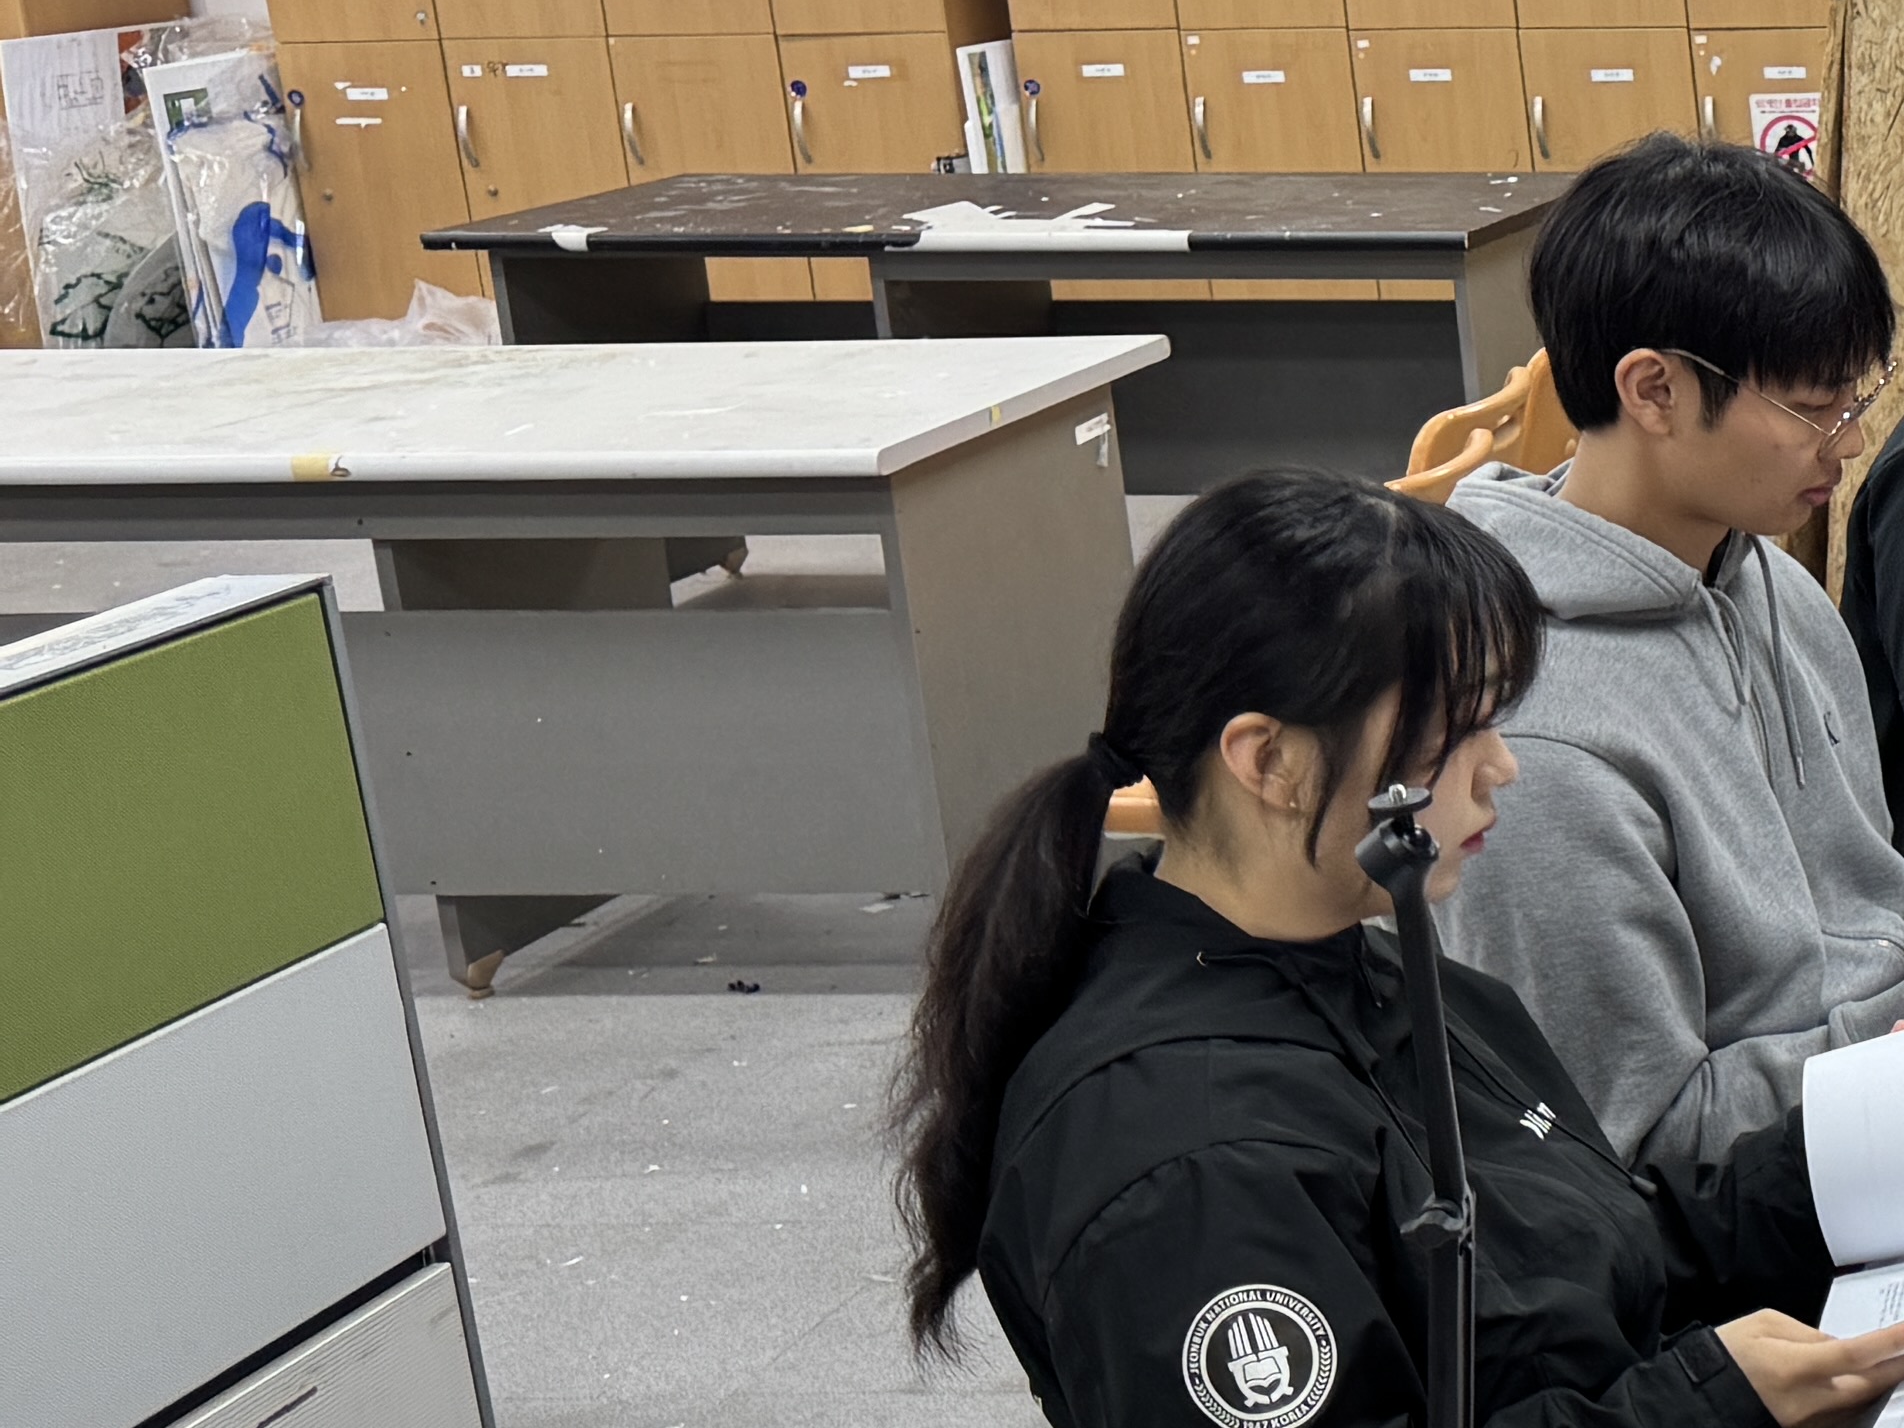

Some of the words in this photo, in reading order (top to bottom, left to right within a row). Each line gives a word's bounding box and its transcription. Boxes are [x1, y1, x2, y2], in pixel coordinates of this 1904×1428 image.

[1189, 1321, 1208, 1374] JEONBUK
[1206, 1290, 1262, 1322] NATIONAL
[1266, 1290, 1327, 1339] UNIVERSITY
[1271, 1404, 1310, 1428] KOREA
